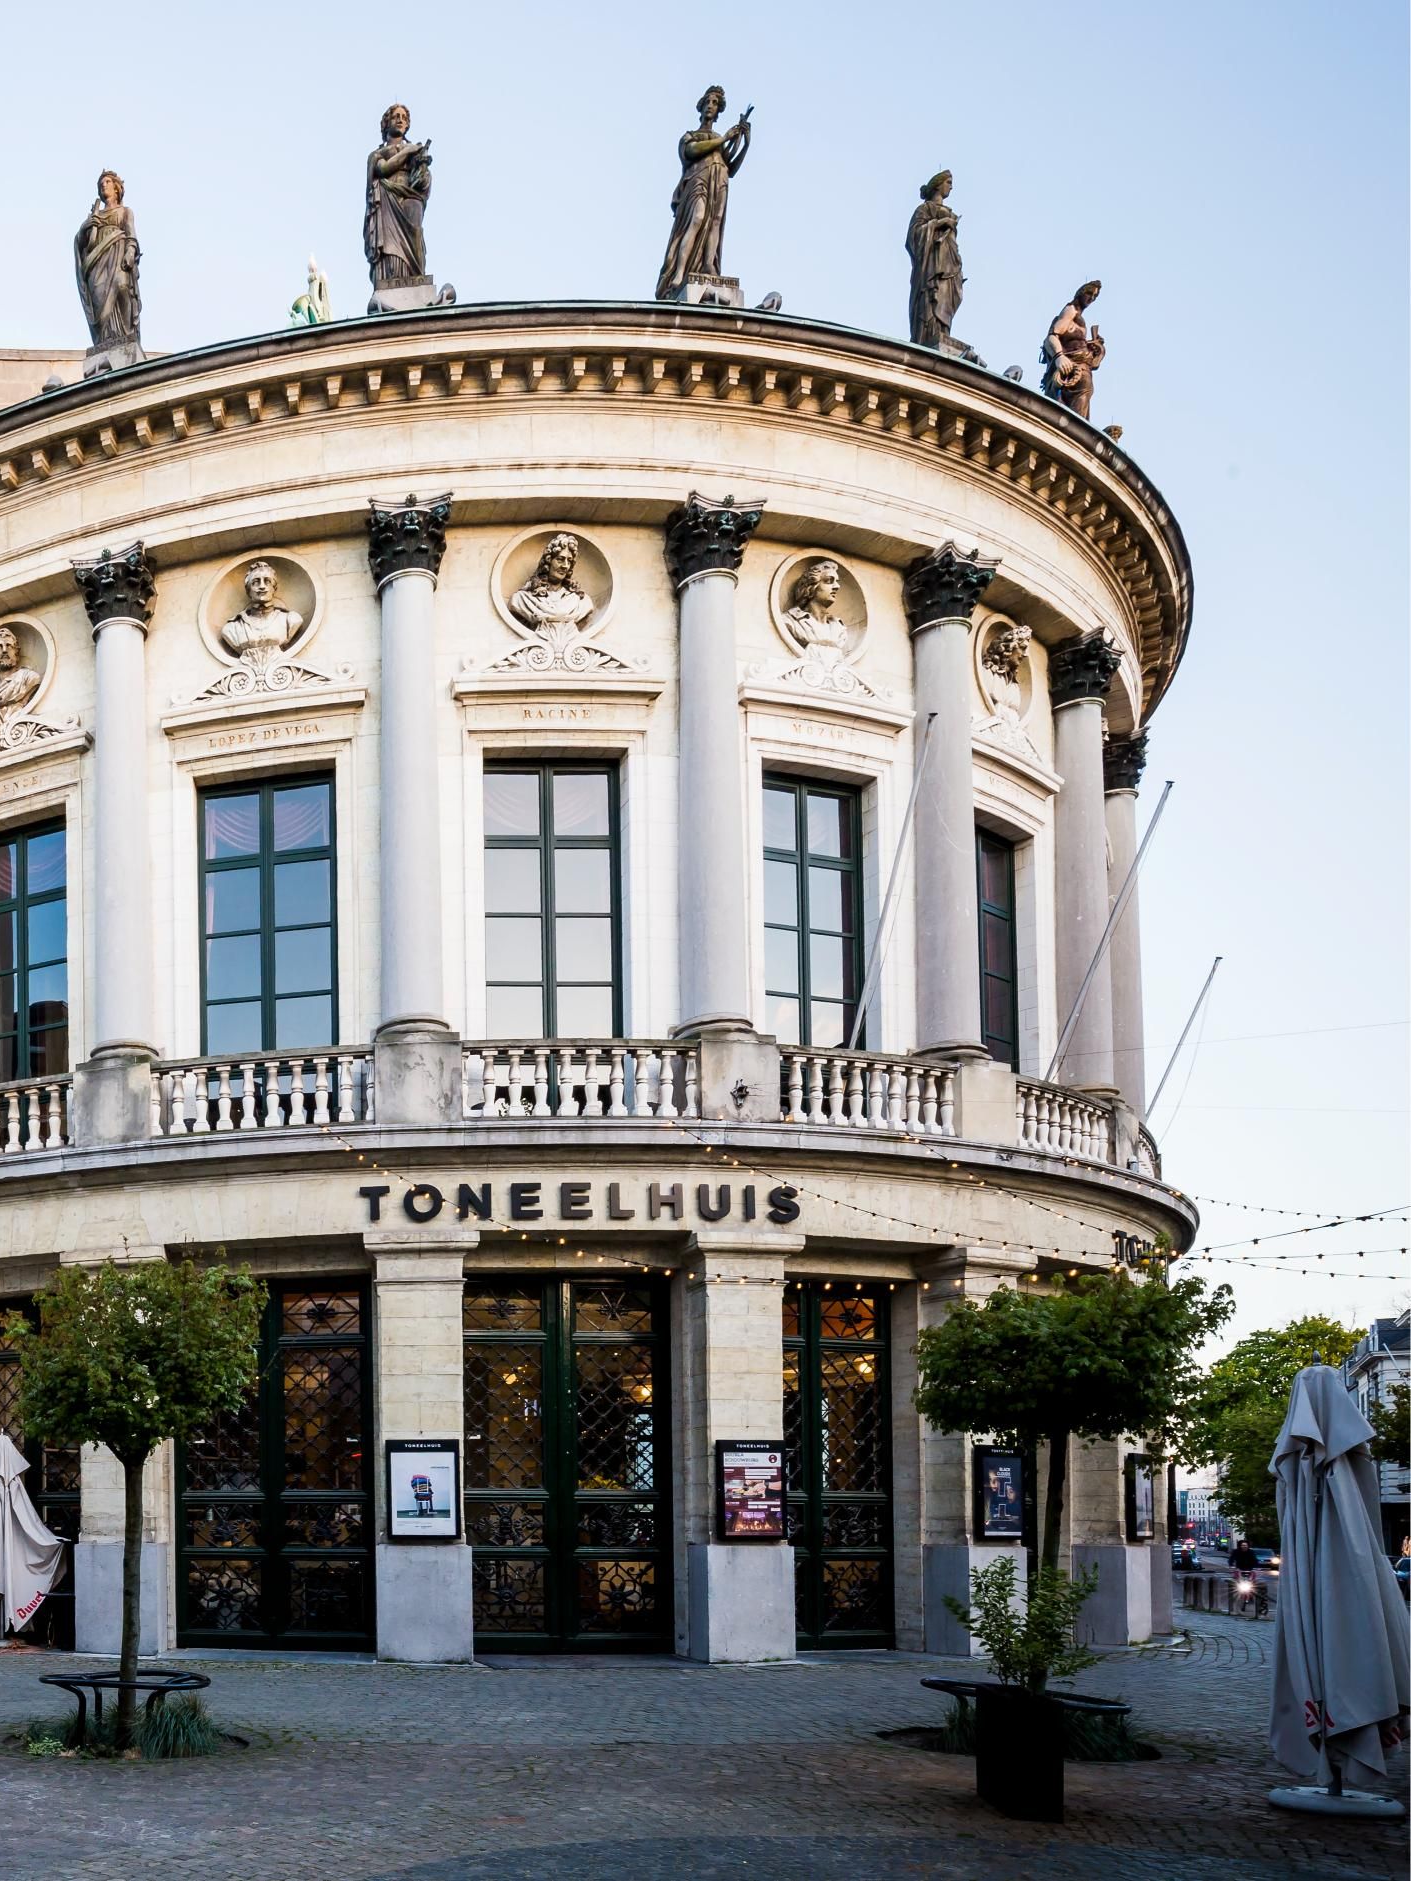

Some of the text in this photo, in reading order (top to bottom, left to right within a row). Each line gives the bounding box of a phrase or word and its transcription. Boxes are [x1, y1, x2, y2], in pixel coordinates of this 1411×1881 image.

[523, 708, 591, 719] RACINE
[208, 732, 256, 748] LOPEZ
[263, 728, 281, 740] DE
[359, 1182, 802, 1223] TONEELHUIS
